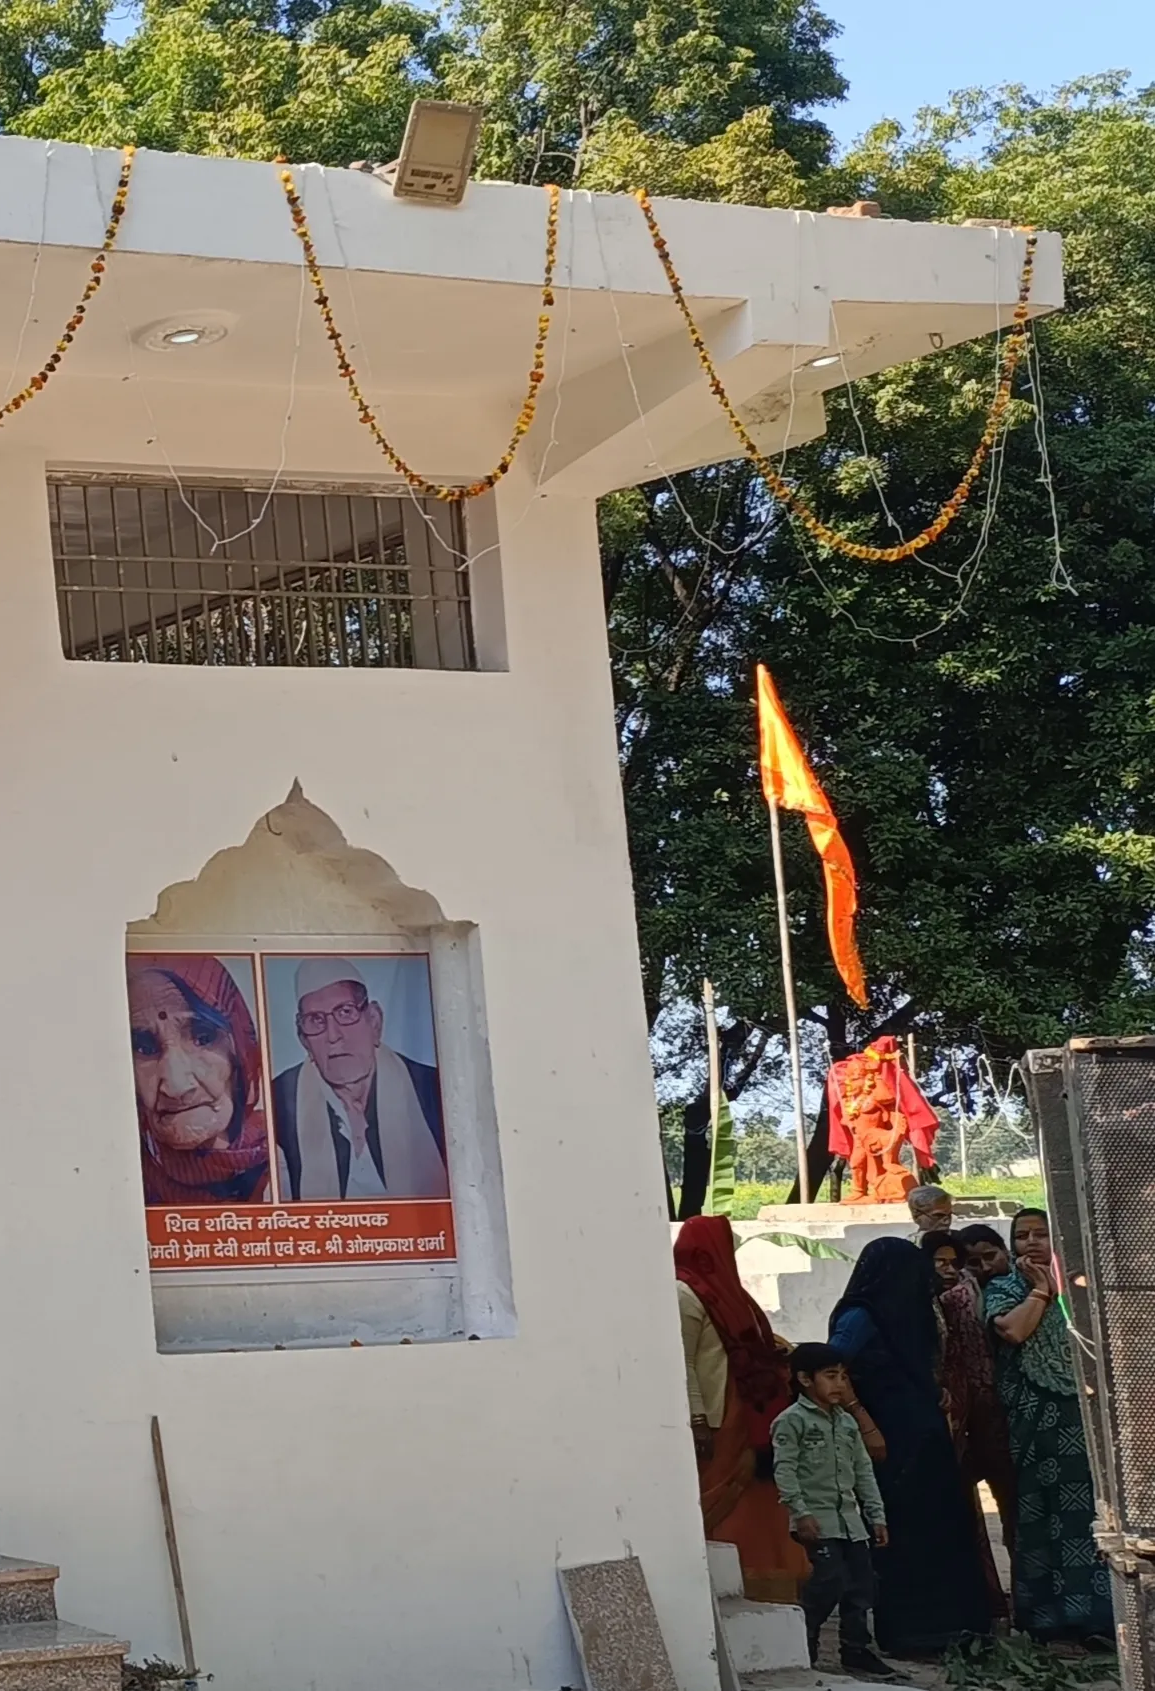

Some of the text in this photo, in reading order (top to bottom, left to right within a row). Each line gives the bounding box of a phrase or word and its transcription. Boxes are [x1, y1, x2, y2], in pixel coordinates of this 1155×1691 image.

[165, 1209, 389, 1233] शिव शक्ति मन्दिर संस्थापक
[183, 1239, 210, 1262] प्रेमा
[213, 1237, 239, 1258] देवी
[242, 1236, 271, 1257] शर्मा
[273, 1236, 294, 1257] एवं
[297, 1239, 322, 1256] स्व.
[325, 1234, 343, 1255] श्री
[346, 1234, 414, 1256] ओमप्रकाश
[417, 1230, 446, 1252] शर्मा
